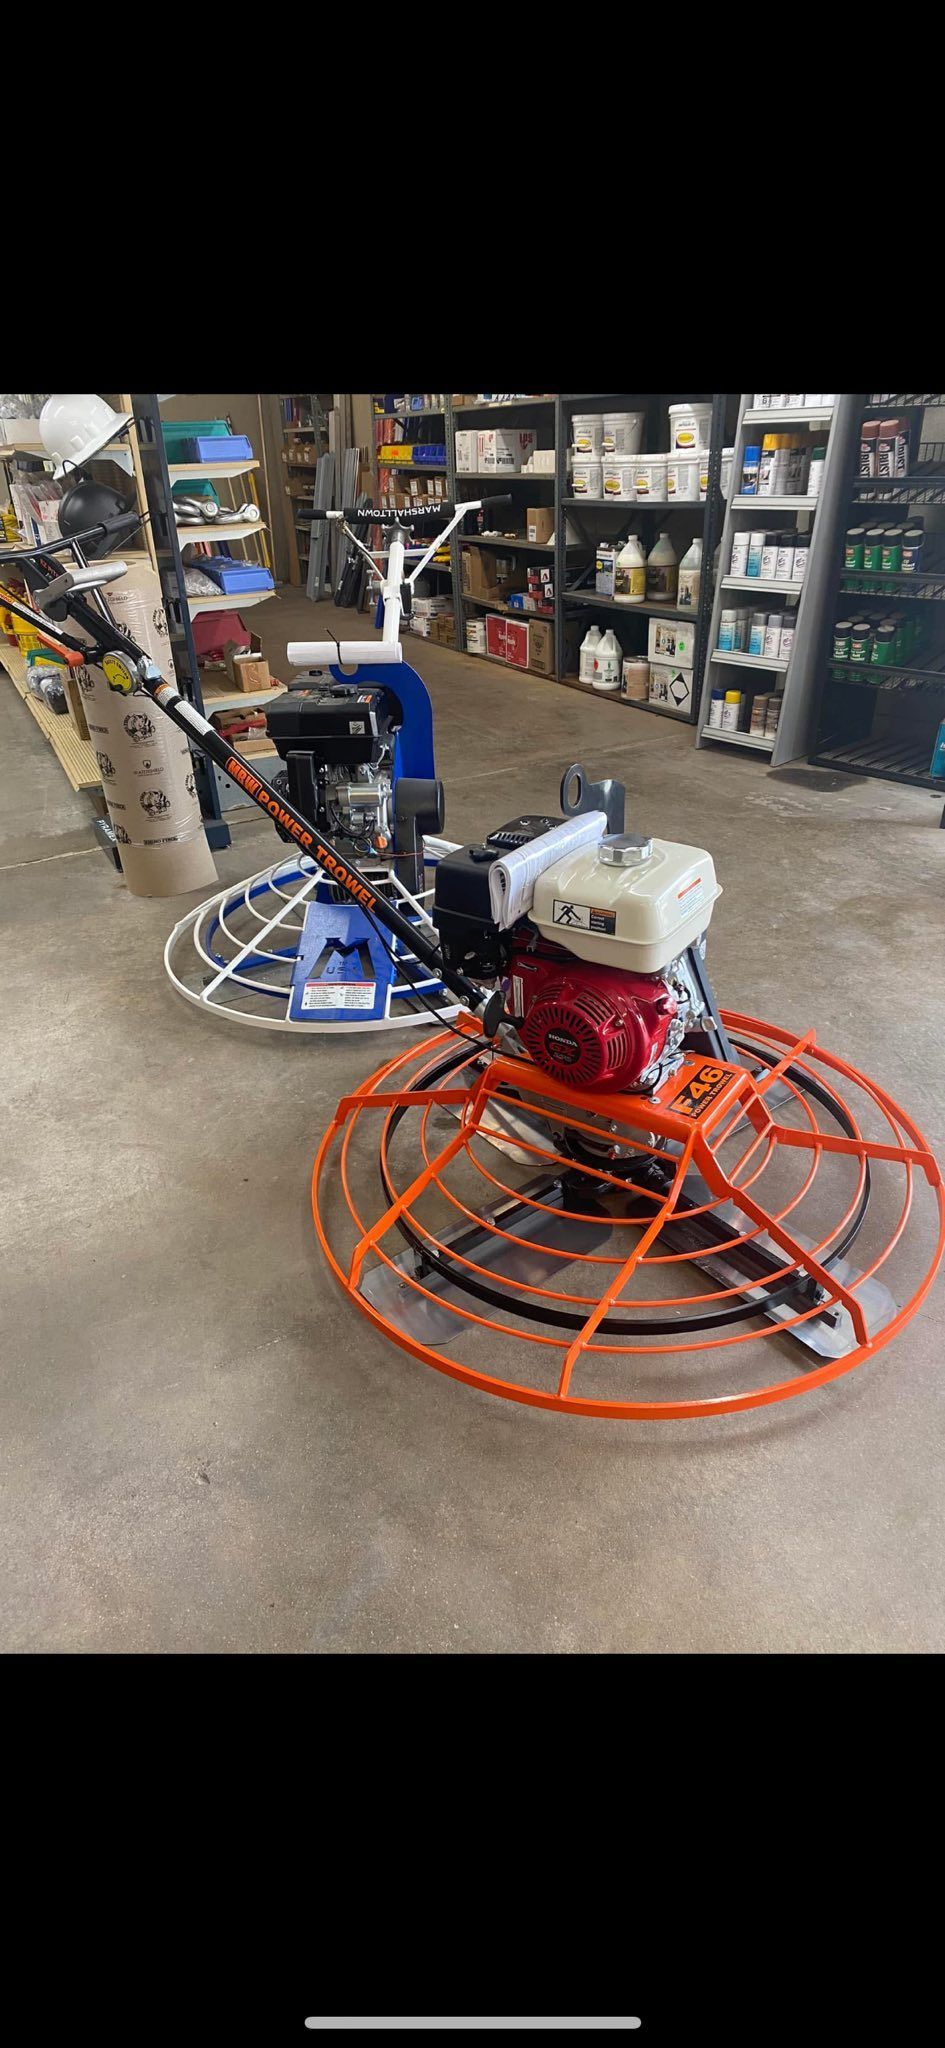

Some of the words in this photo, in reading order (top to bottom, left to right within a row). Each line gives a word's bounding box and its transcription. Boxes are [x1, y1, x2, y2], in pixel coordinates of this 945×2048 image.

[357, 504, 441, 517] MARSHALLTOWN
[258, 790, 313, 846] POWER
[316, 845, 377, 913] TROWEL
[548, 1033, 578, 1048] HONDA
[690, 1095, 713, 1117] POWER
[709, 1073, 733, 1097] TROWEL
